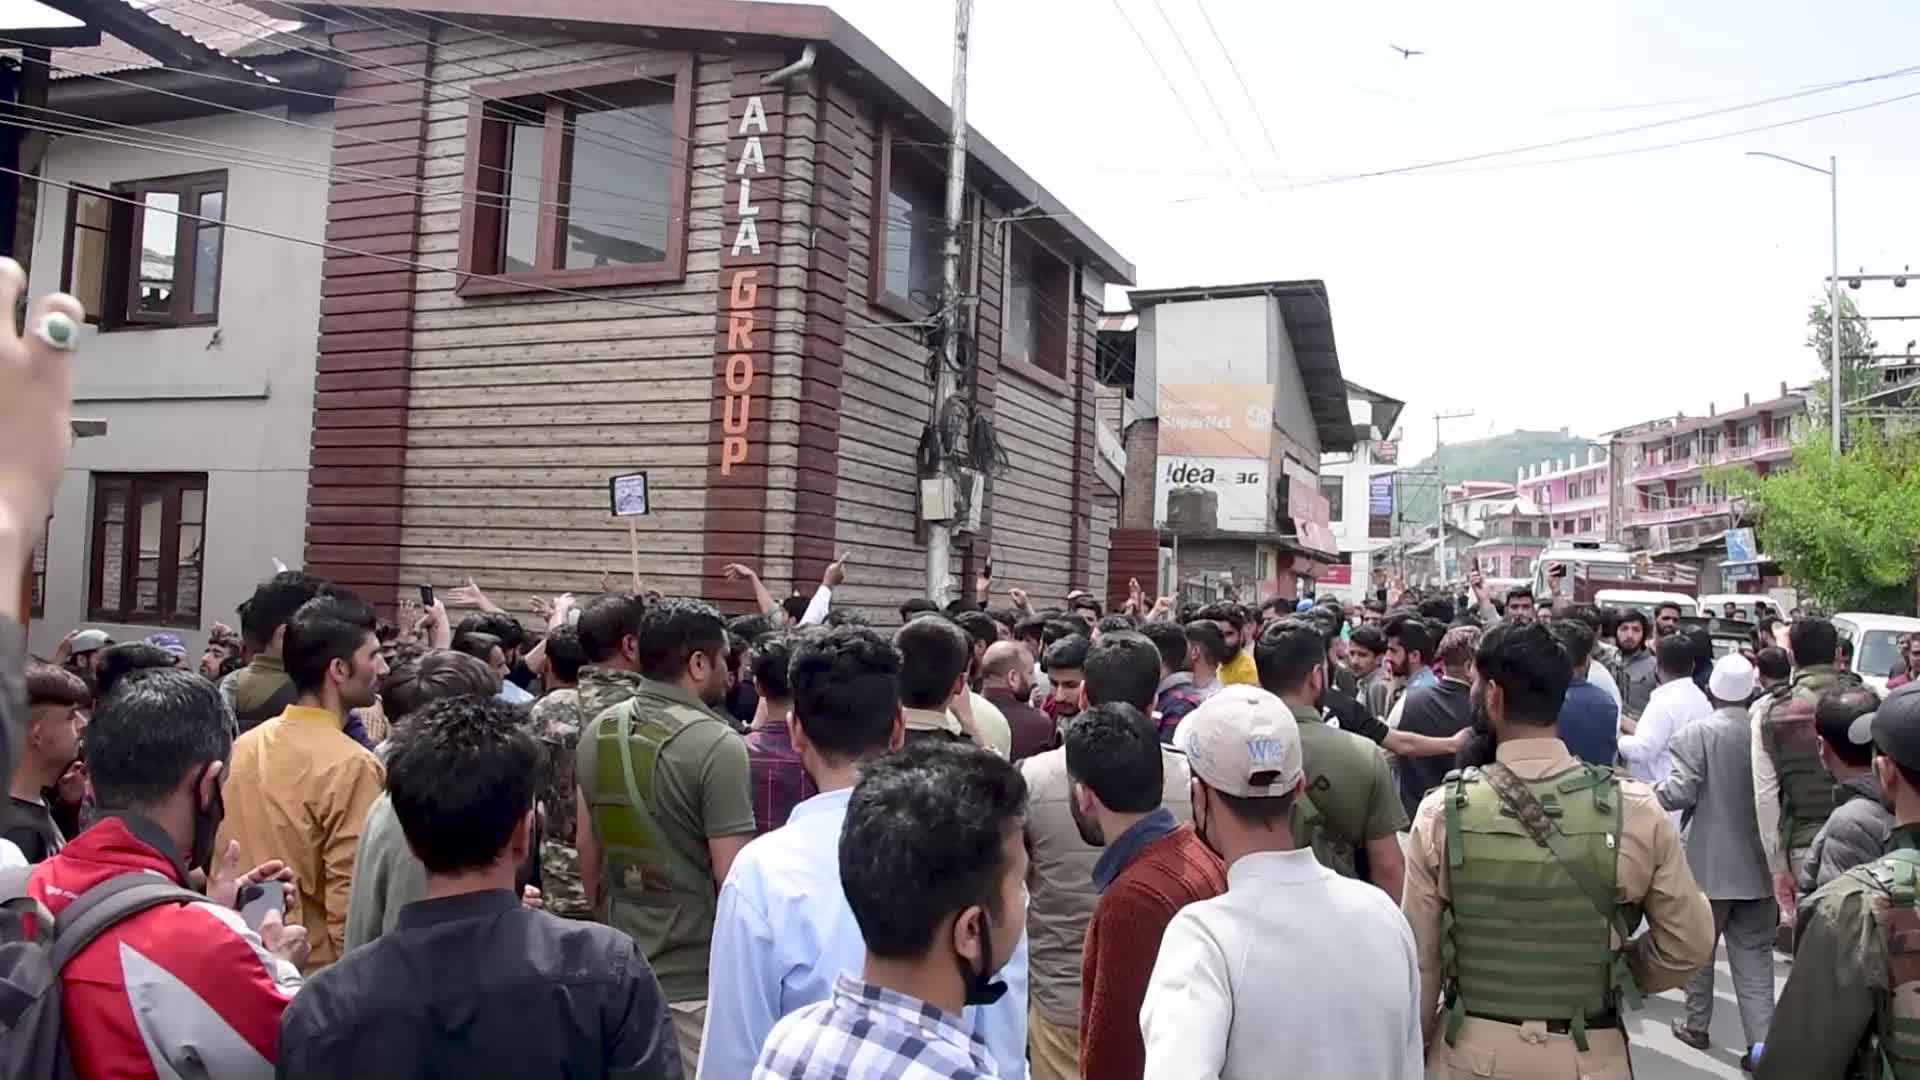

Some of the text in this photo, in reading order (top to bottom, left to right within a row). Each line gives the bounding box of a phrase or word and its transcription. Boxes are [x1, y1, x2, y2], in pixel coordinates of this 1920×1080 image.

[721, 96, 769, 477] AALA GROUP
[1235, 472, 1260, 485] 3G
